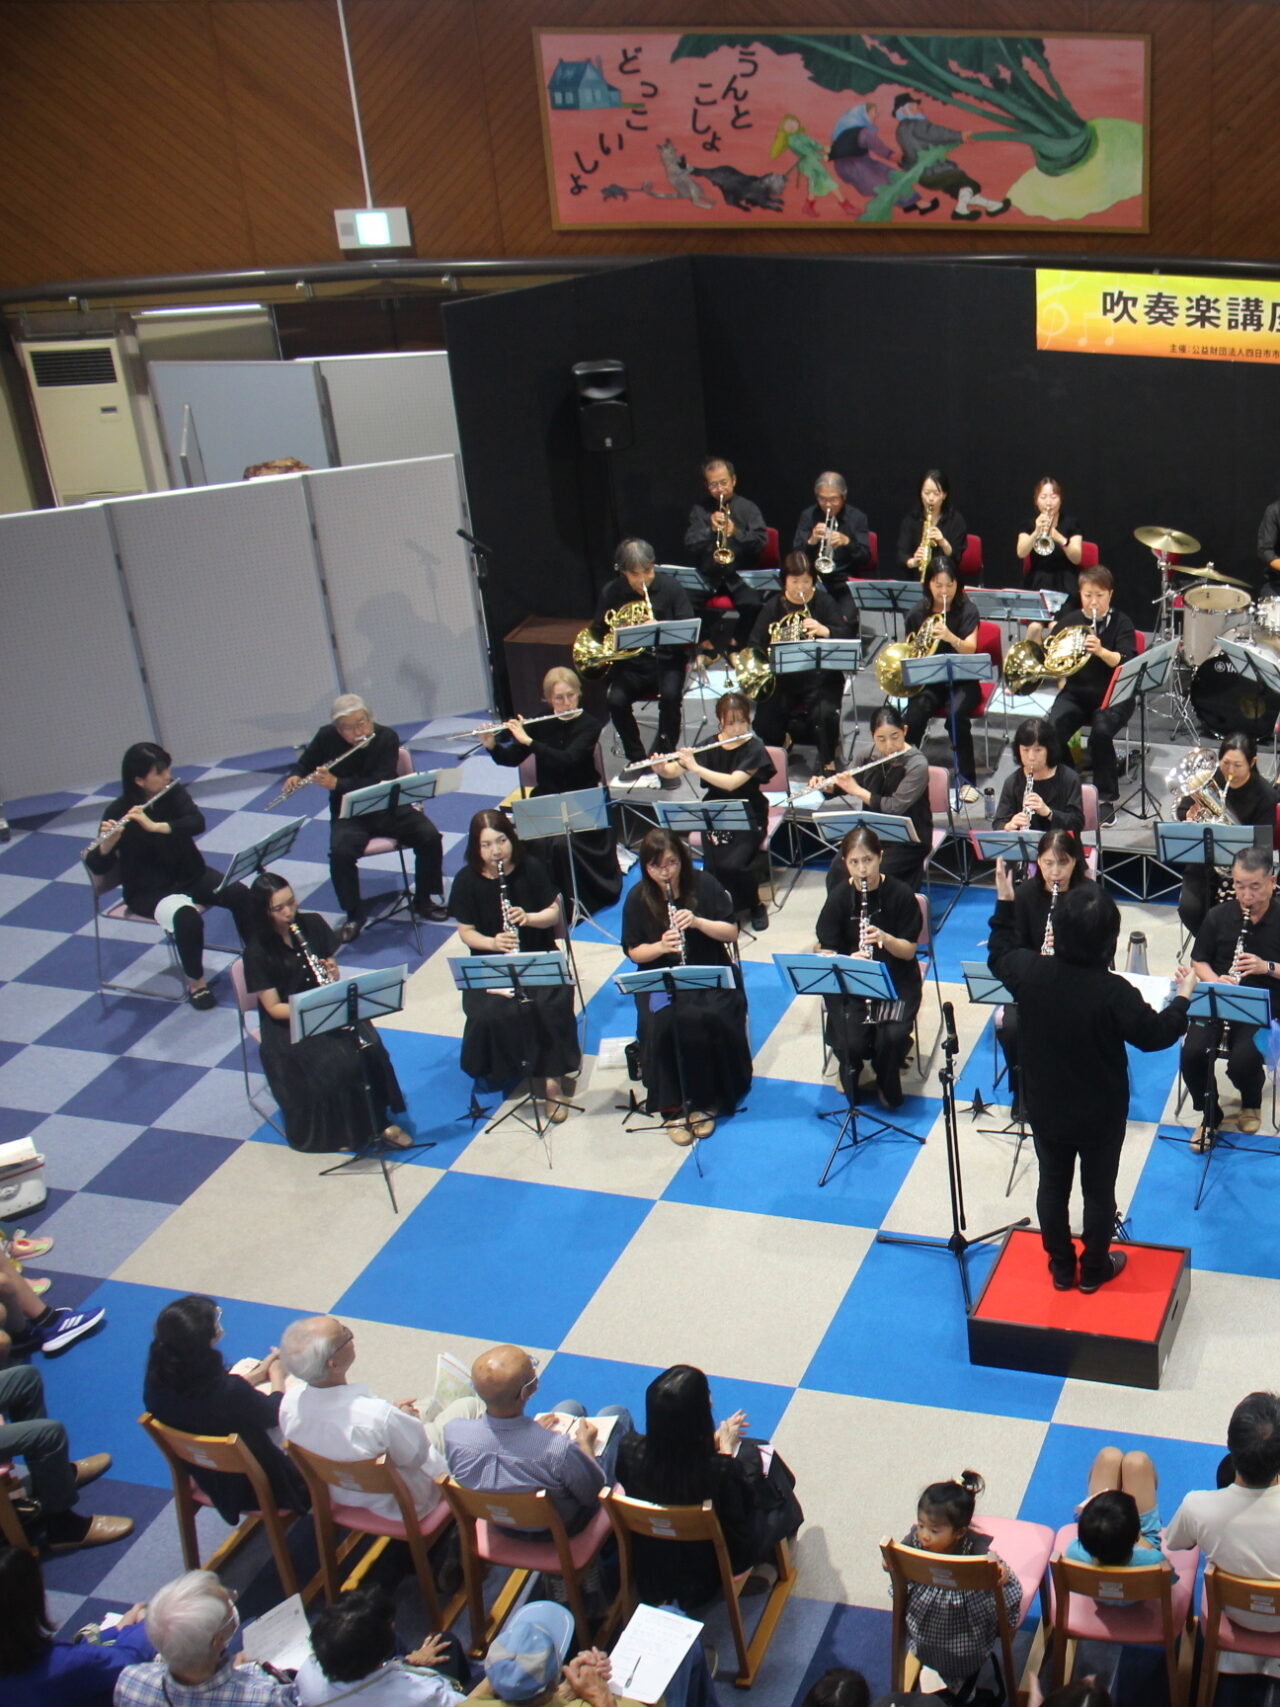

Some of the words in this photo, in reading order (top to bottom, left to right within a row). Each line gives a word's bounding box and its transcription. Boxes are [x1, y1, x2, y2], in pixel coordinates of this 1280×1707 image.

[569, 46, 659, 196] どっこいしょ
[692, 82, 722, 152] こしょ
[721, 50, 759, 130] うんと
